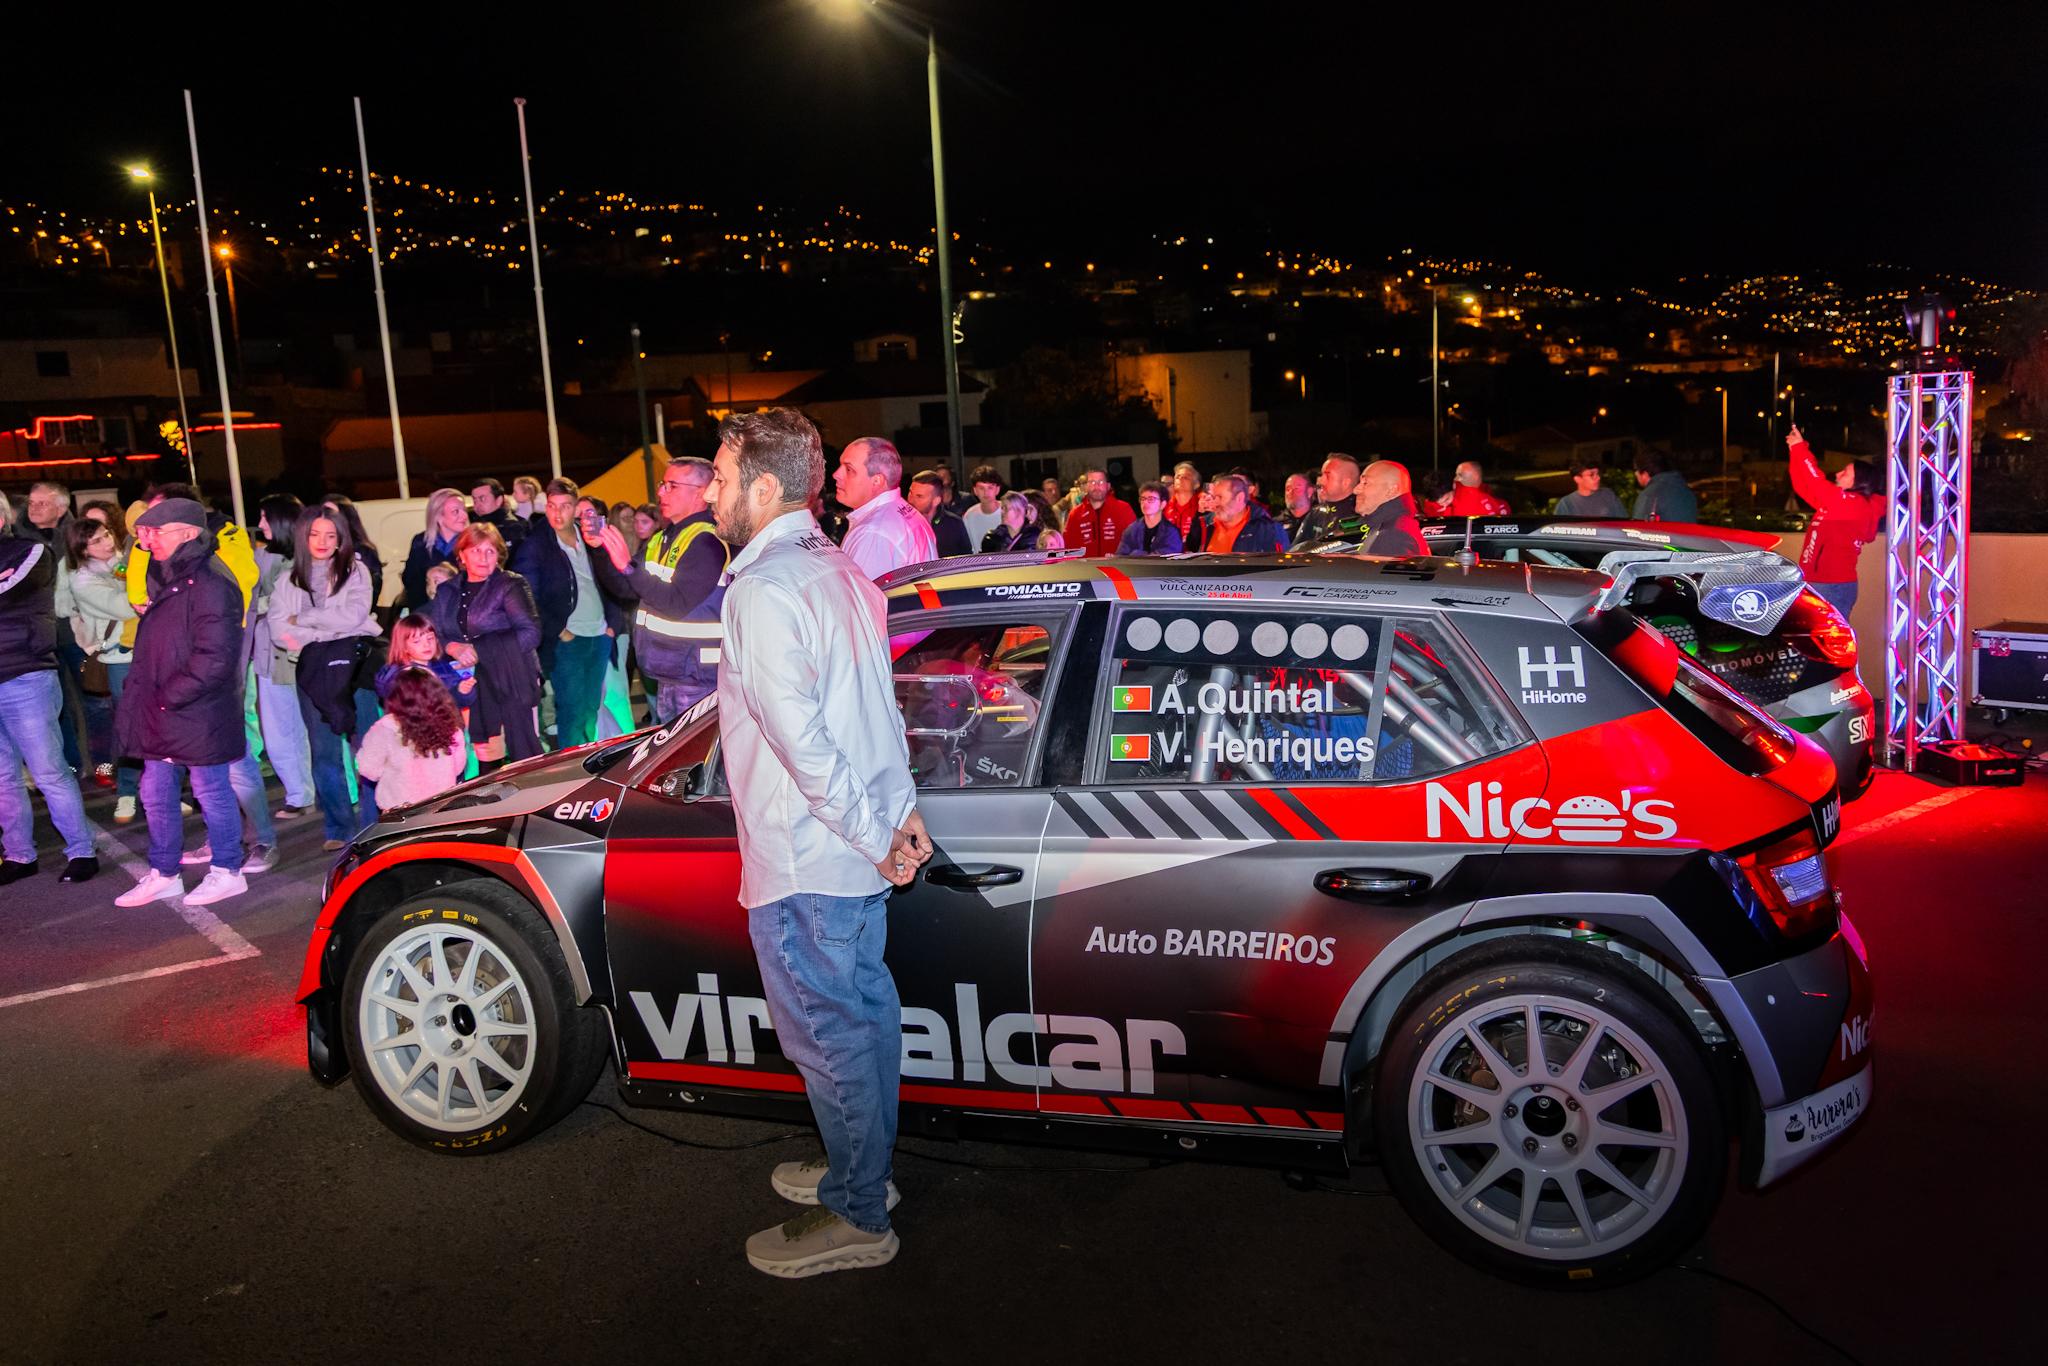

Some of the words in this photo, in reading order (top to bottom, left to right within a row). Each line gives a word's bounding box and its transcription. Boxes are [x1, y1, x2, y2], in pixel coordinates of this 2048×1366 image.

[985, 582, 1081, 596] TOMIAUTO
[1159, 584, 1253, 592] VULCANIZADORA
[1282, 586, 1325, 597] FC
[1325, 587, 1398, 596] FERNANDO
[1323, 592, 1369, 600] CAIRES
[1522, 690, 1587, 704] HiHome
[1157, 731, 1192, 763] V.
[1202, 731, 1375, 771] Henriques
[553, 800, 595, 820] elf
[1085, 926, 1157, 954] Auto
[1163, 928, 1336, 966] BARREIROS
[1807, 1084, 1861, 1130] Aurora's
